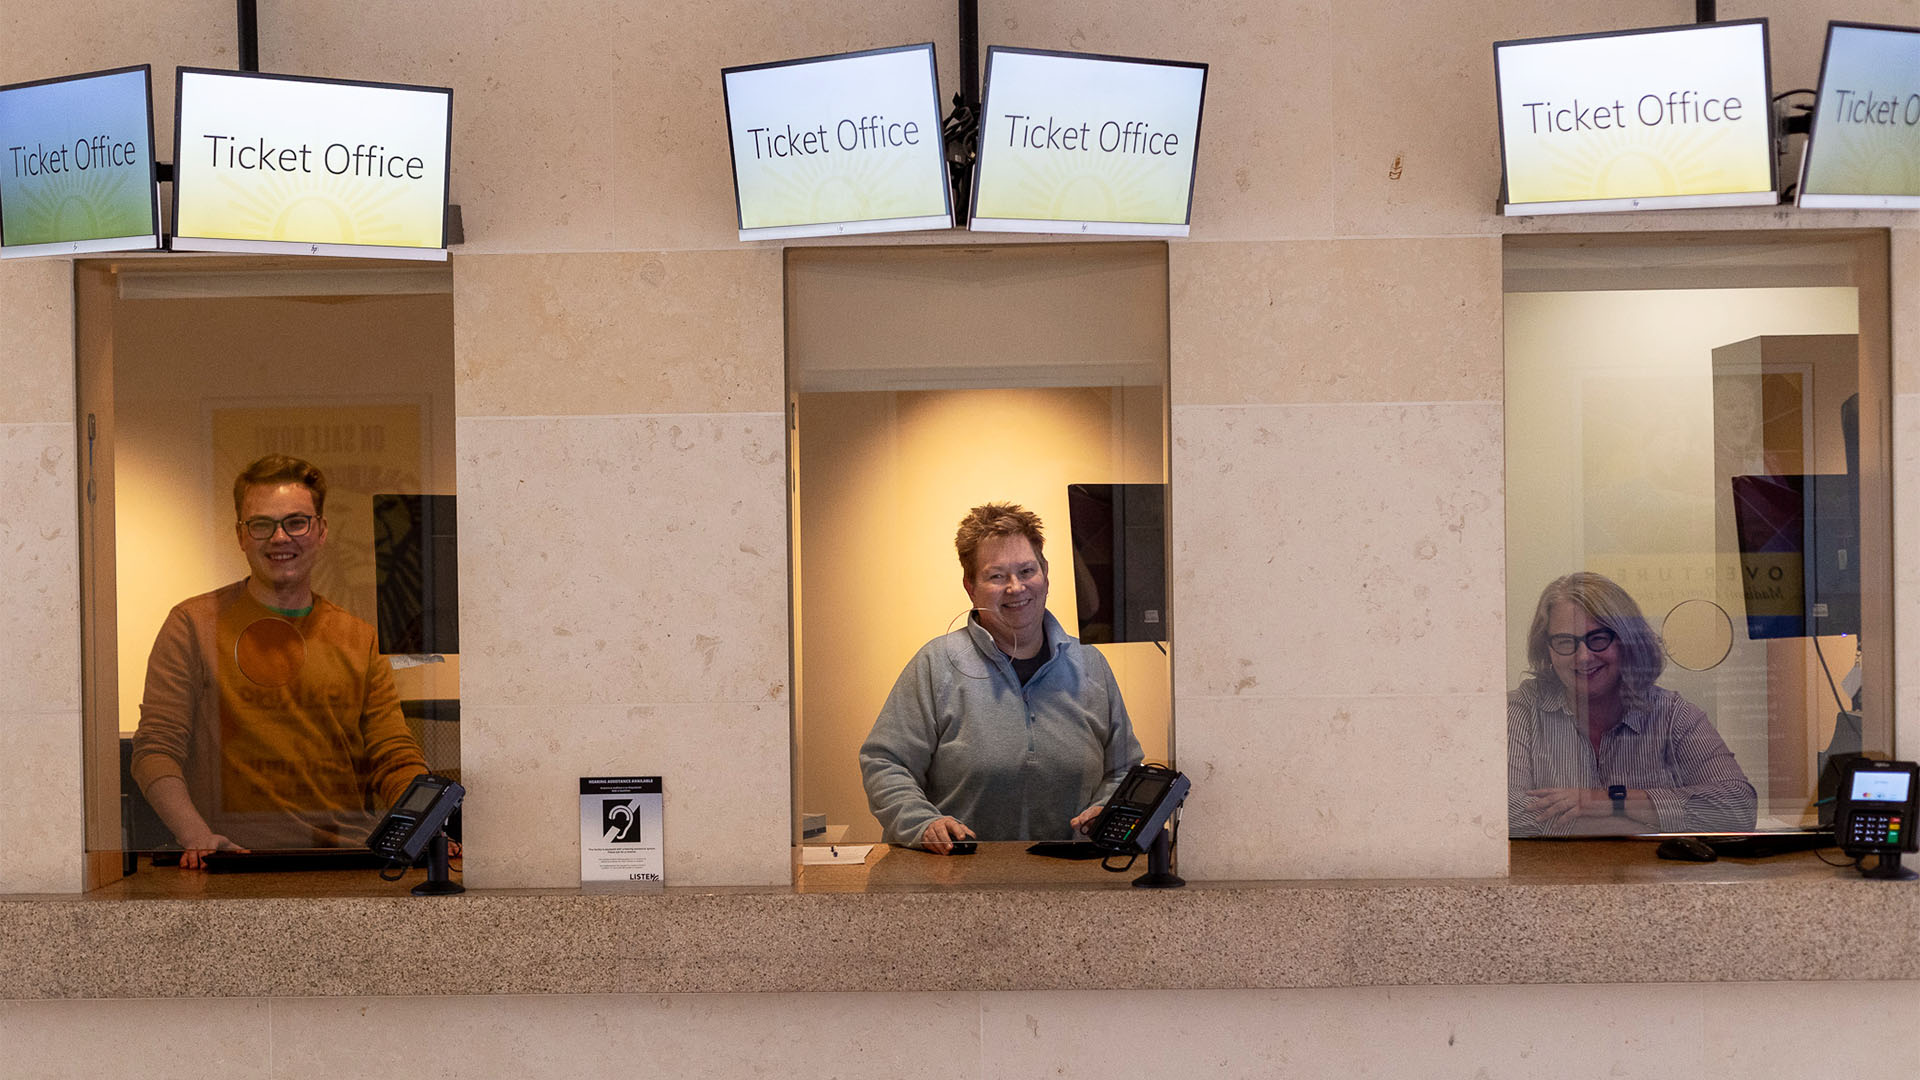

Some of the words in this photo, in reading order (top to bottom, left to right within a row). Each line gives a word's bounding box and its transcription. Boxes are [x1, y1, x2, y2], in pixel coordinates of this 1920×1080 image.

[1521, 99, 1626, 134] Ticket
[1637, 90, 1743, 127] Office
[1835, 89, 1900, 126] Ticket
[8, 143, 70, 178] Ticket
[74, 134, 136, 171] Office
[203, 134, 312, 174] Ticket
[324, 143, 425, 180] Office
[746, 124, 830, 161] Ticket
[836, 115, 920, 152] Office
[1004, 114, 1091, 152] Ticket
[1099, 120, 1180, 156] Office
